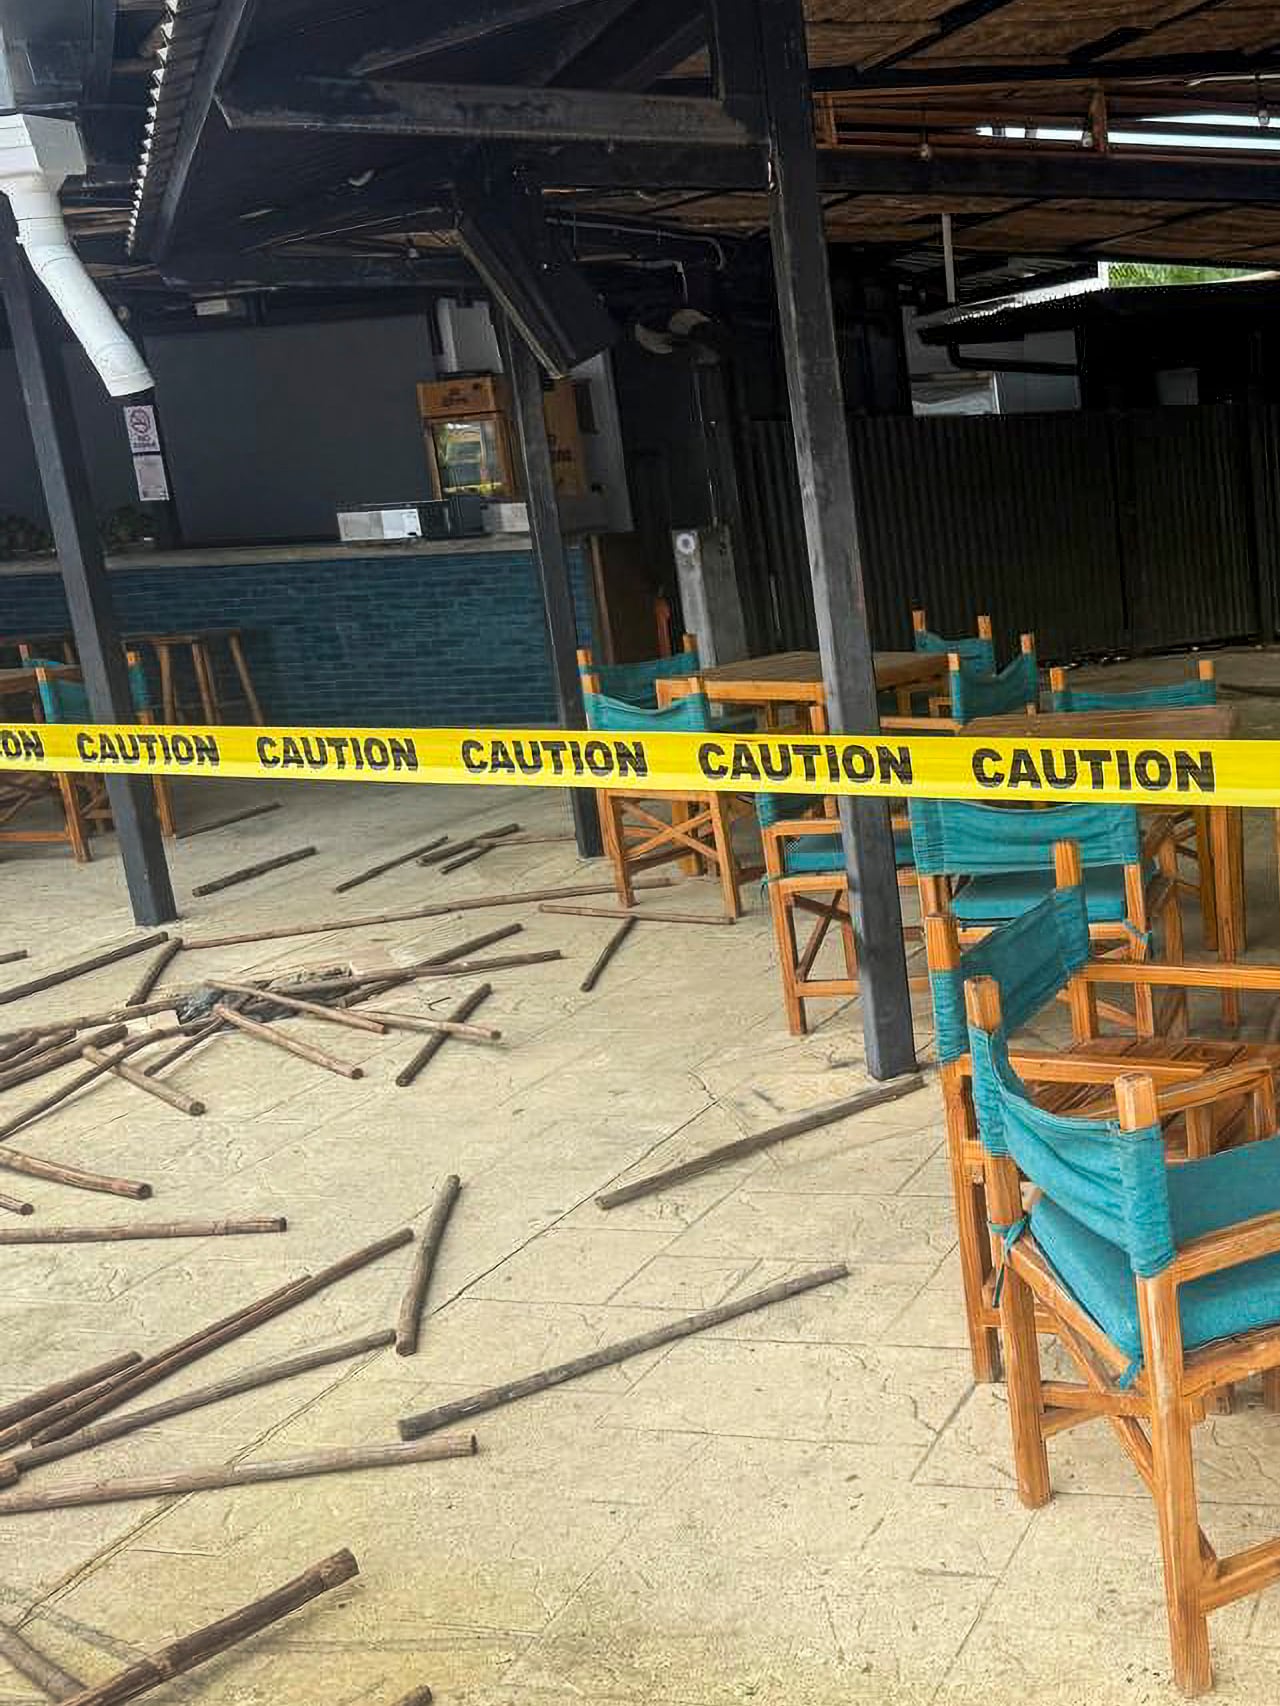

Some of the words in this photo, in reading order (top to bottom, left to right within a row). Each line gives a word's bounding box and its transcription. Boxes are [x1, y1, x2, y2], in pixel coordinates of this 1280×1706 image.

[0, 730, 45, 759] ON
[77, 732, 220, 765] CAUTION
[256, 737, 419, 771] CAUTION
[461, 740, 648, 777] CAUTION
[698, 742, 913, 785] CAUTION
[971, 748, 1216, 793] CAUTION
